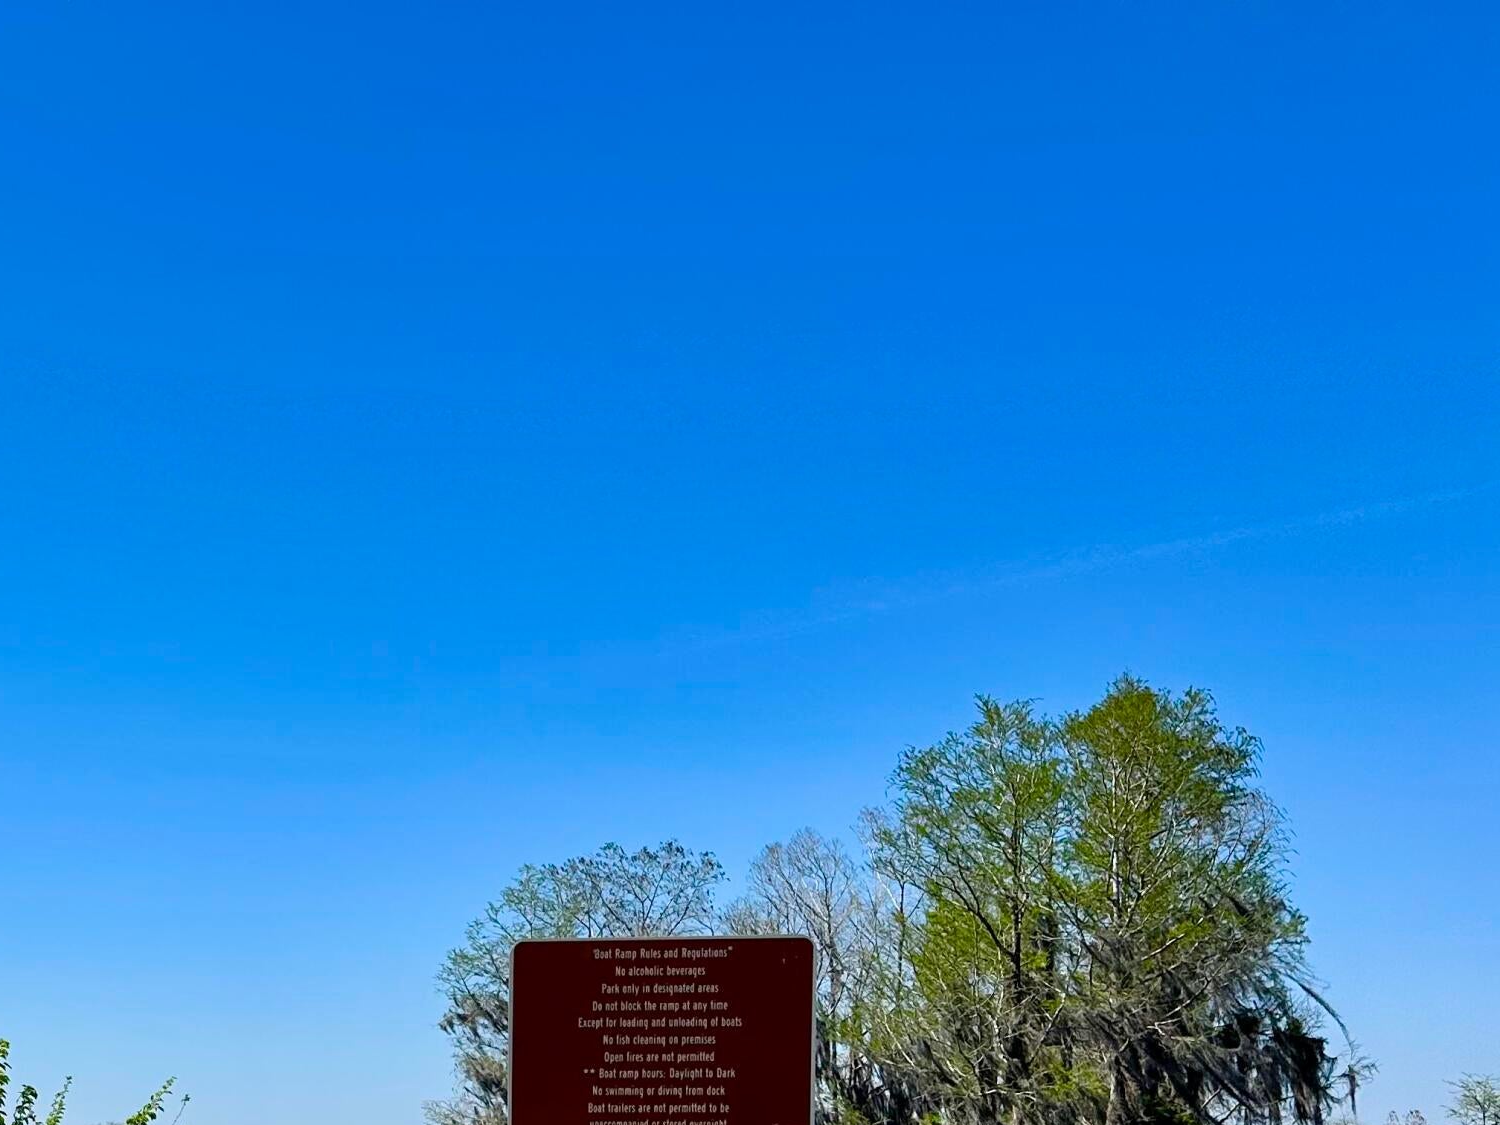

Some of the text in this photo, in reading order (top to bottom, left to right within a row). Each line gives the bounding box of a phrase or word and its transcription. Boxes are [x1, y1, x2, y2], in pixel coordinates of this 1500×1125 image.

[614, 949, 637, 960] Ramp
[640, 948, 661, 958] Rules
[663, 948, 679, 958] and
[615, 966, 706, 978] No alcoholic beverages
[601, 984, 620, 993] Park
[622, 984, 640, 995] only
[642, 984, 651, 993] in
[653, 983, 695, 996] designated
[592, 1000, 728, 1012] Do not block the ramp at any time
[578, 1017, 743, 1030] Except for loading and unloading of boats
[603, 1035, 716, 1046] No fish cleaning on premises
[604, 1052, 715, 1064] Open fires are not permitted
[599, 1068, 617, 1078] Boat
[619, 1071, 640, 1079] ramp
[641, 1069, 666, 1078] hours:
[669, 1068, 703, 1080] Daylight
[705, 1068, 714, 1078] to
[716, 1068, 736, 1078] Dark
[592, 1086, 603, 1095] No
[605, 1086, 644, 1098] swimming
[657, 1086, 683, 1098] diving
[685, 1085, 704, 1095] from
[706, 1086, 726, 1095] dock
[587, 1103, 730, 1114] Boat trailers are not permitted to be
